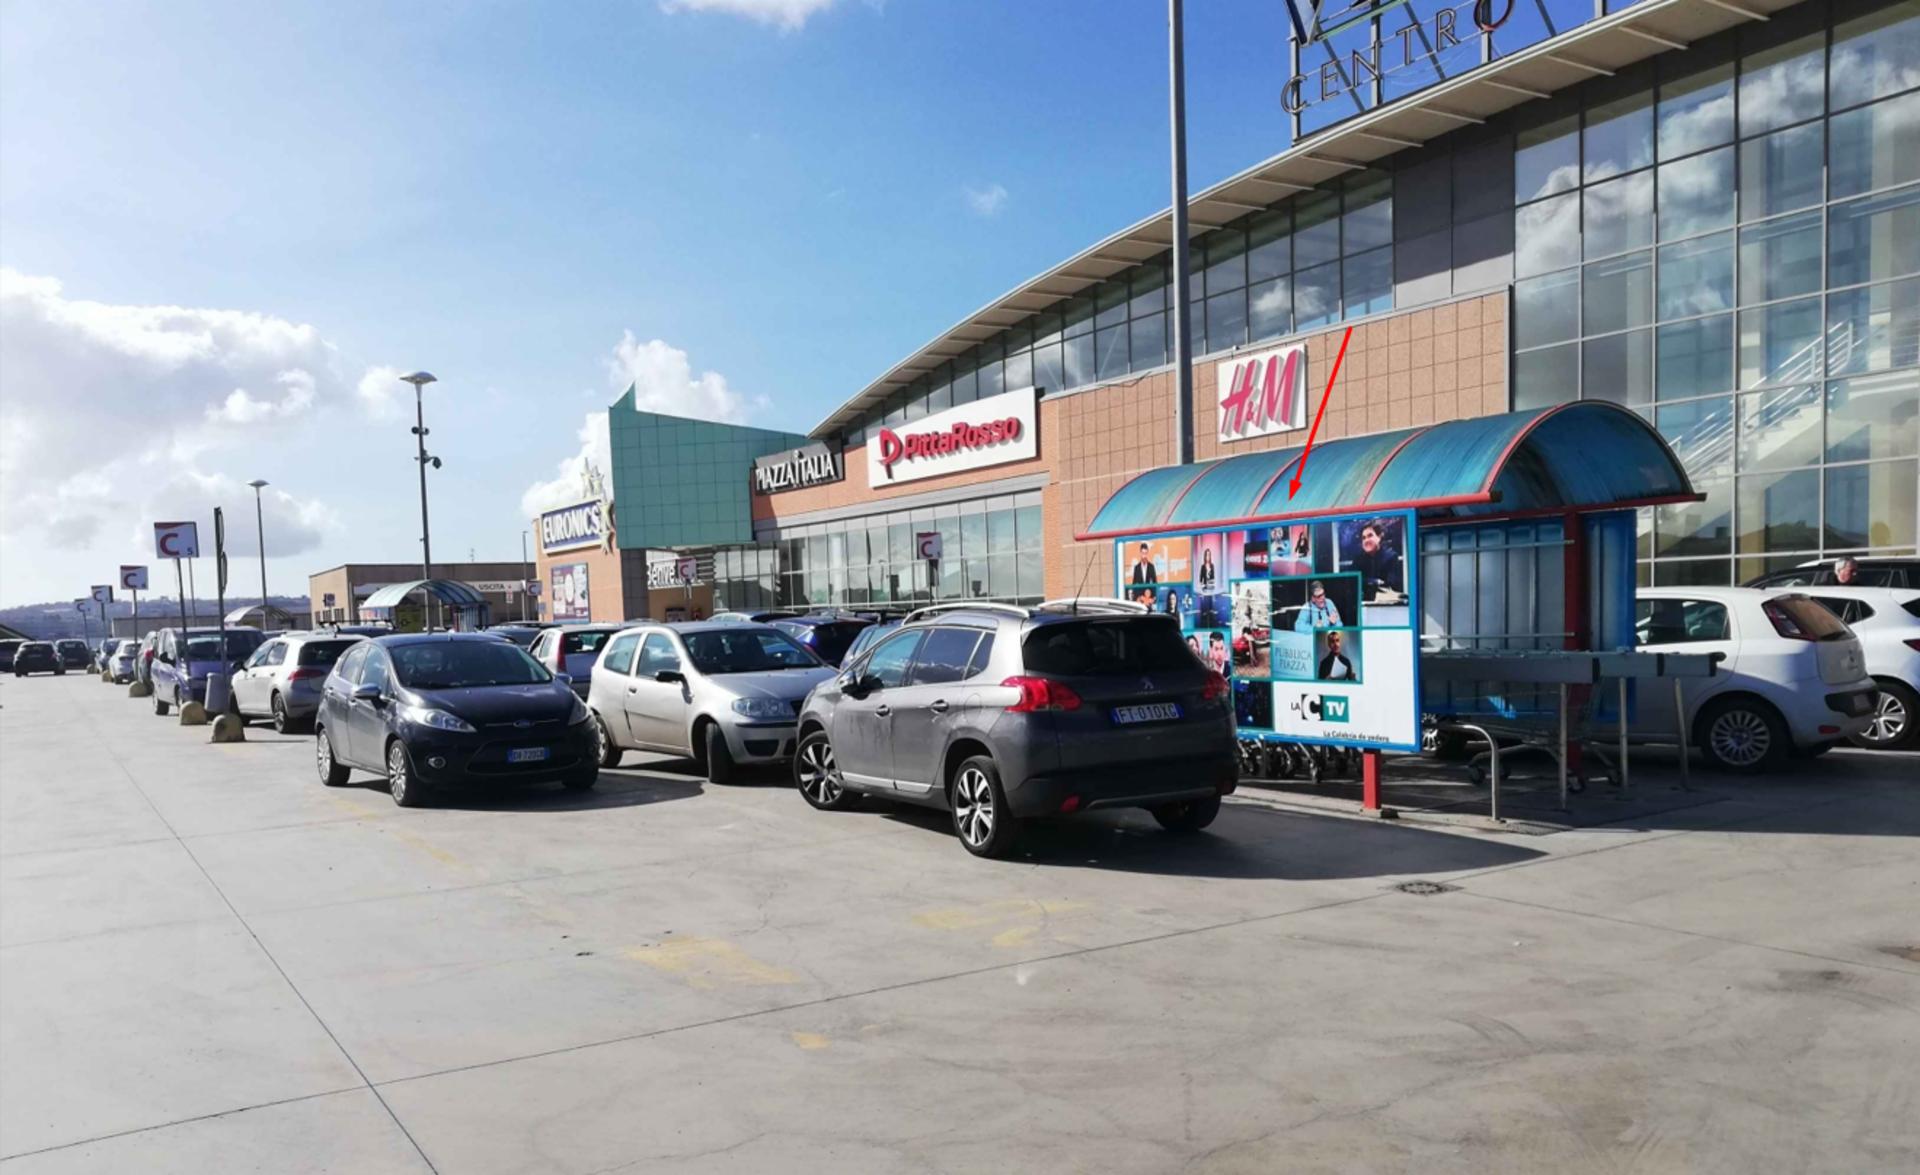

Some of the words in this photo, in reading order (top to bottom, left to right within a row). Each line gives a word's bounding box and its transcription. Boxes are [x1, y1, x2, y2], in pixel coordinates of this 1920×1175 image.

[1220, 349, 1300, 435] H&M
[904, 416, 1022, 461] PittaRosso
[755, 462, 795, 491] PIAZZA
[794, 449, 835, 485] ITALIA
[543, 506, 600, 543] EURONICS
[160, 532, 180, 556] C
[920, 540, 934, 558] C
[679, 564, 690, 578] C
[123, 572, 138, 589] C
[1274, 647, 1312, 661] PUBBLICA
[1279, 658, 1308, 672] PIAZZA
[1325, 701, 1346, 717] TV
